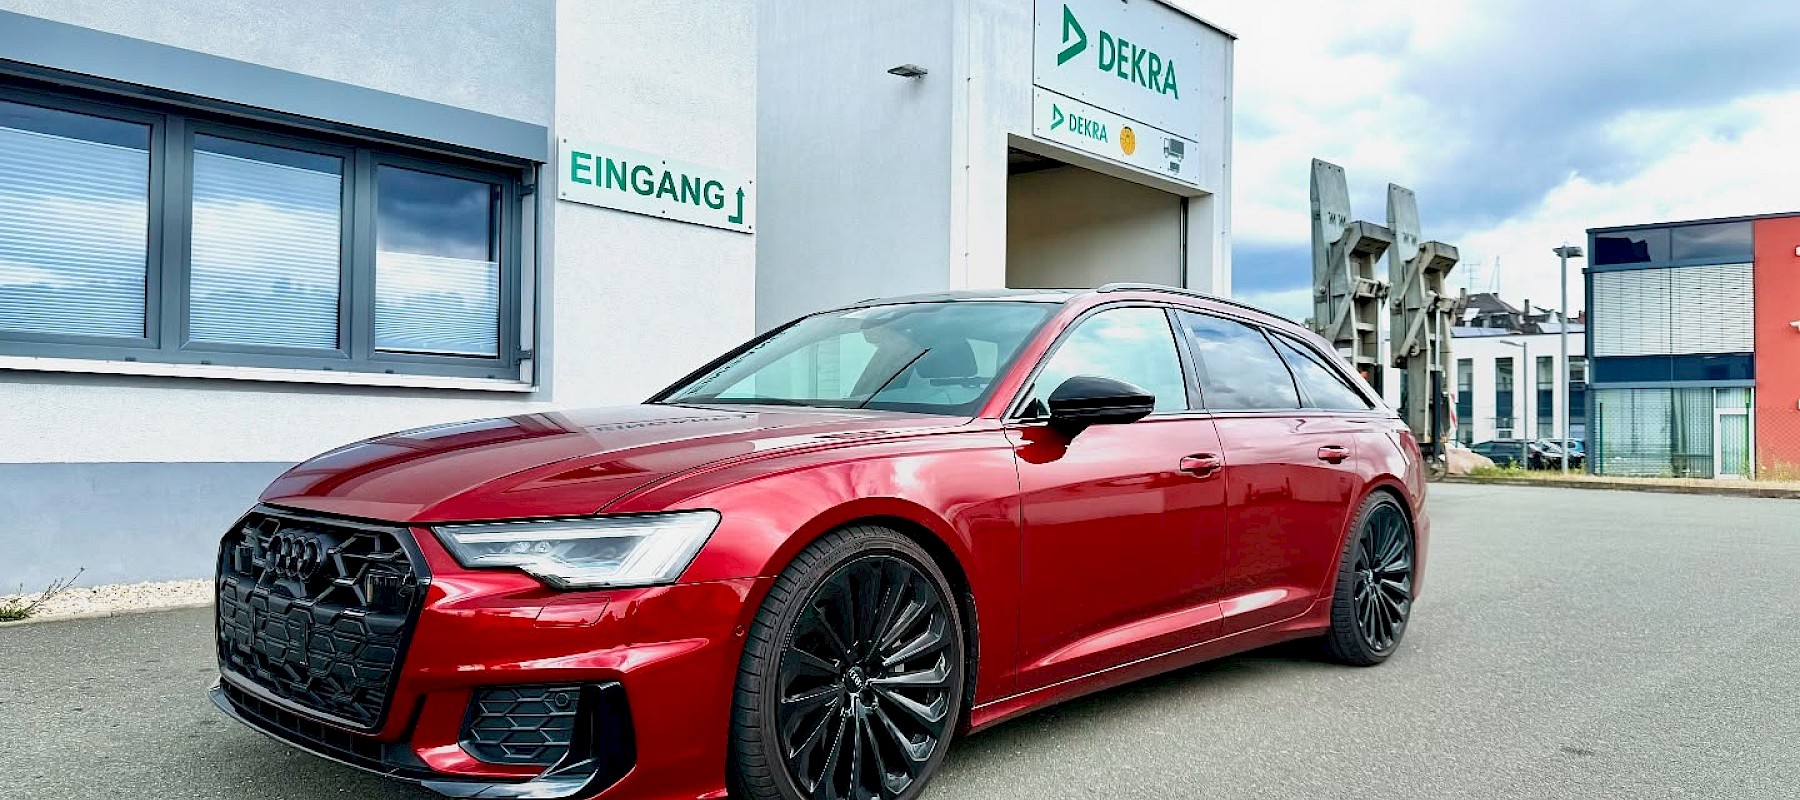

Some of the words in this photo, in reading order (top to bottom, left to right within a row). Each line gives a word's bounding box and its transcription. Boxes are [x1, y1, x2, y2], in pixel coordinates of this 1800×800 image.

[1098, 29, 1179, 100] DEKRA
[1069, 114, 1109, 143] DEKRA
[571, 150, 725, 209] EINGANG
